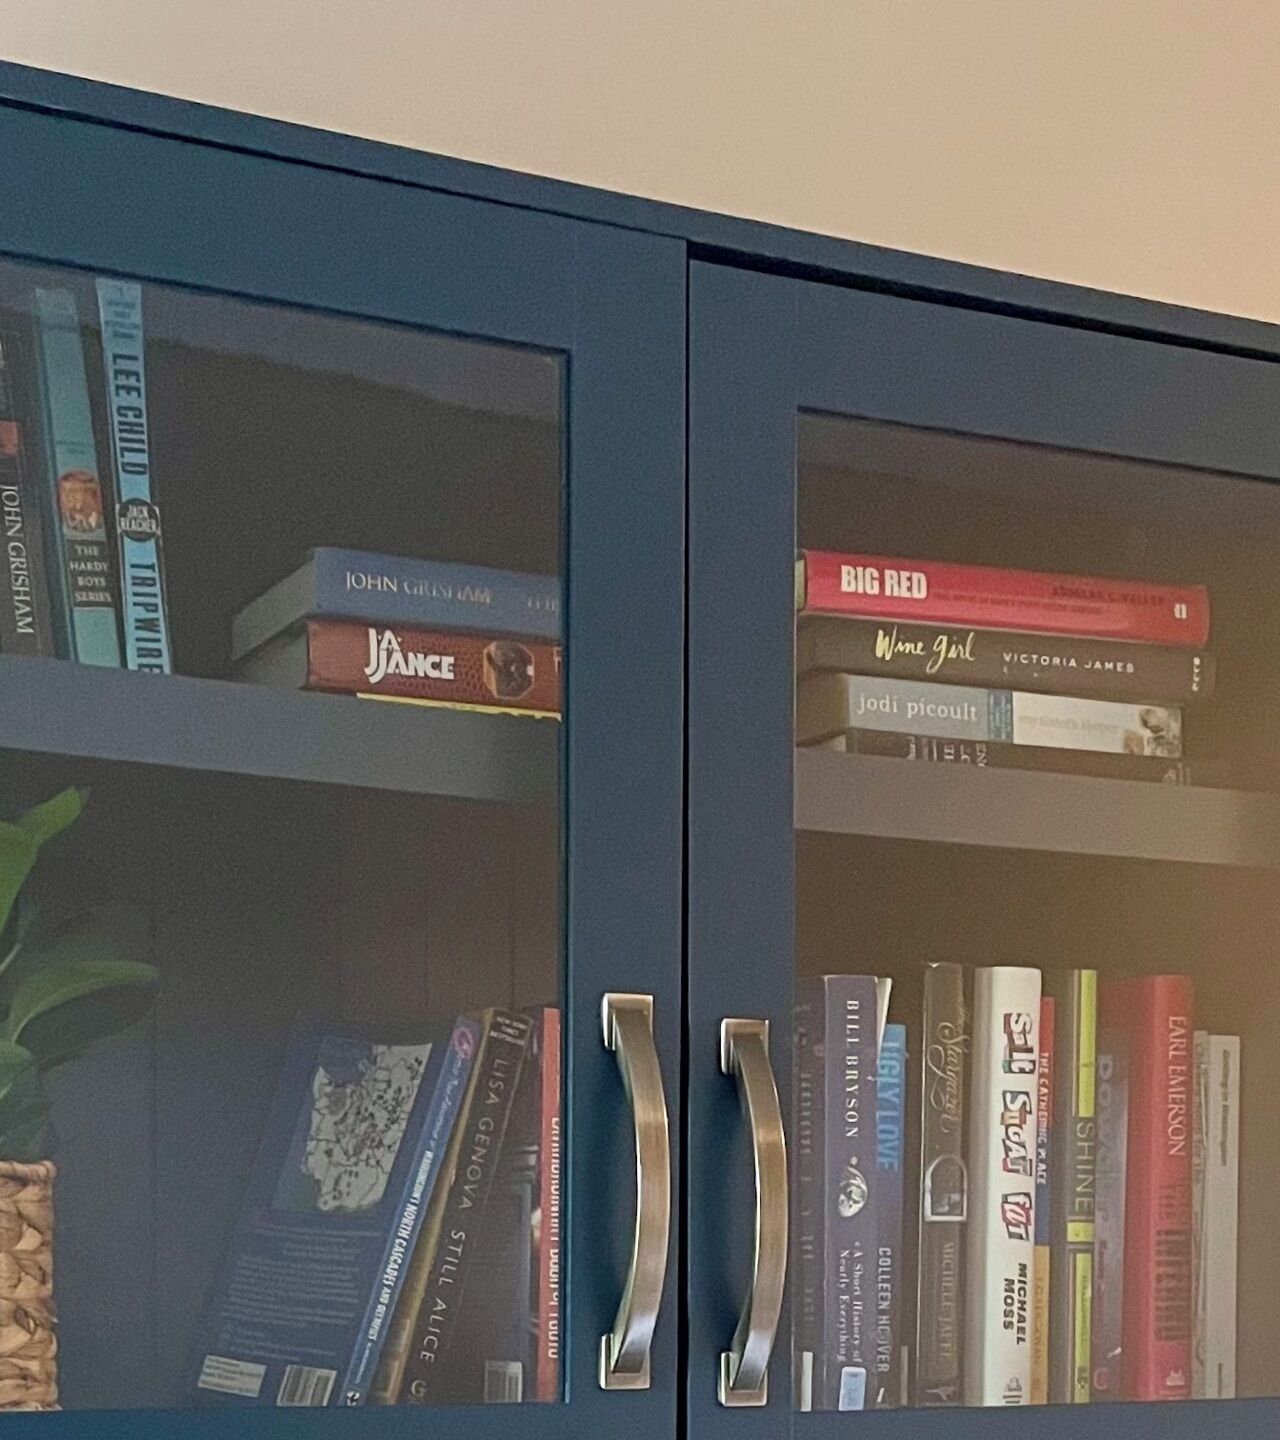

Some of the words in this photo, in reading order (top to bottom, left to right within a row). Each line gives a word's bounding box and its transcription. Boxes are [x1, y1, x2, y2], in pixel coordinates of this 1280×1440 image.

[112, 352, 141, 398] LEE
[116, 405, 148, 475] CHILD
[127, 503, 149, 519] JACK
[70, 560, 109, 572] HARDY
[75, 545, 99, 556] THE
[7, 541, 35, 634] GRISHAM
[74, 591, 112, 602] SERIES
[77, 576, 107, 586] BOYS
[346, 571, 398, 593] JOHN
[840, 564, 880, 595] BIG
[884, 569, 928, 600] RED
[129, 562, 164, 673] TRIPWIRE
[368, 649, 455, 684] JANCE
[875, 624, 926, 661] Wine
[926, 631, 977, 675] girl
[1002, 651, 1078, 669] VICTORIA
[1084, 660, 1135, 674] JAMES
[857, 692, 898, 715] jodi
[907, 699, 978, 722] picoult
[845, 1000, 860, 1048] BILL
[1168, 1016, 1187, 1060] EARL
[485, 1058, 510, 1105] LISA
[1038, 1051, 1050, 1074] THE
[844, 1055, 860, 1138] BRYSON
[1167, 1065, 1187, 1157] EMERSON
[458, 1116, 495, 1210] GENOVA
[875, 1110, 900, 1173] LOVE
[1036, 1148, 1048, 1186] PLACE
[1075, 1122, 1095, 1212] SHINE
[397, 1203, 419, 1239] NORTH
[382, 1238, 408, 1287] CASCADES
[438, 1229, 466, 1286] STILL
[838, 1250, 851, 1289] Nearly
[852, 1263, 864, 1296] Short
[877, 1247, 892, 1311] COLLEEN
[852, 1301, 864, 1345] History
[1003, 1277, 1015, 1331] MOSS
[1016, 1262, 1028, 1345] MICHAEL
[420, 1296, 448, 1364] ALICE
[837, 1295, 851, 1363] Everything
[877, 1315, 892, 1373] HOOVER
[852, 1347, 863, 1363] of
